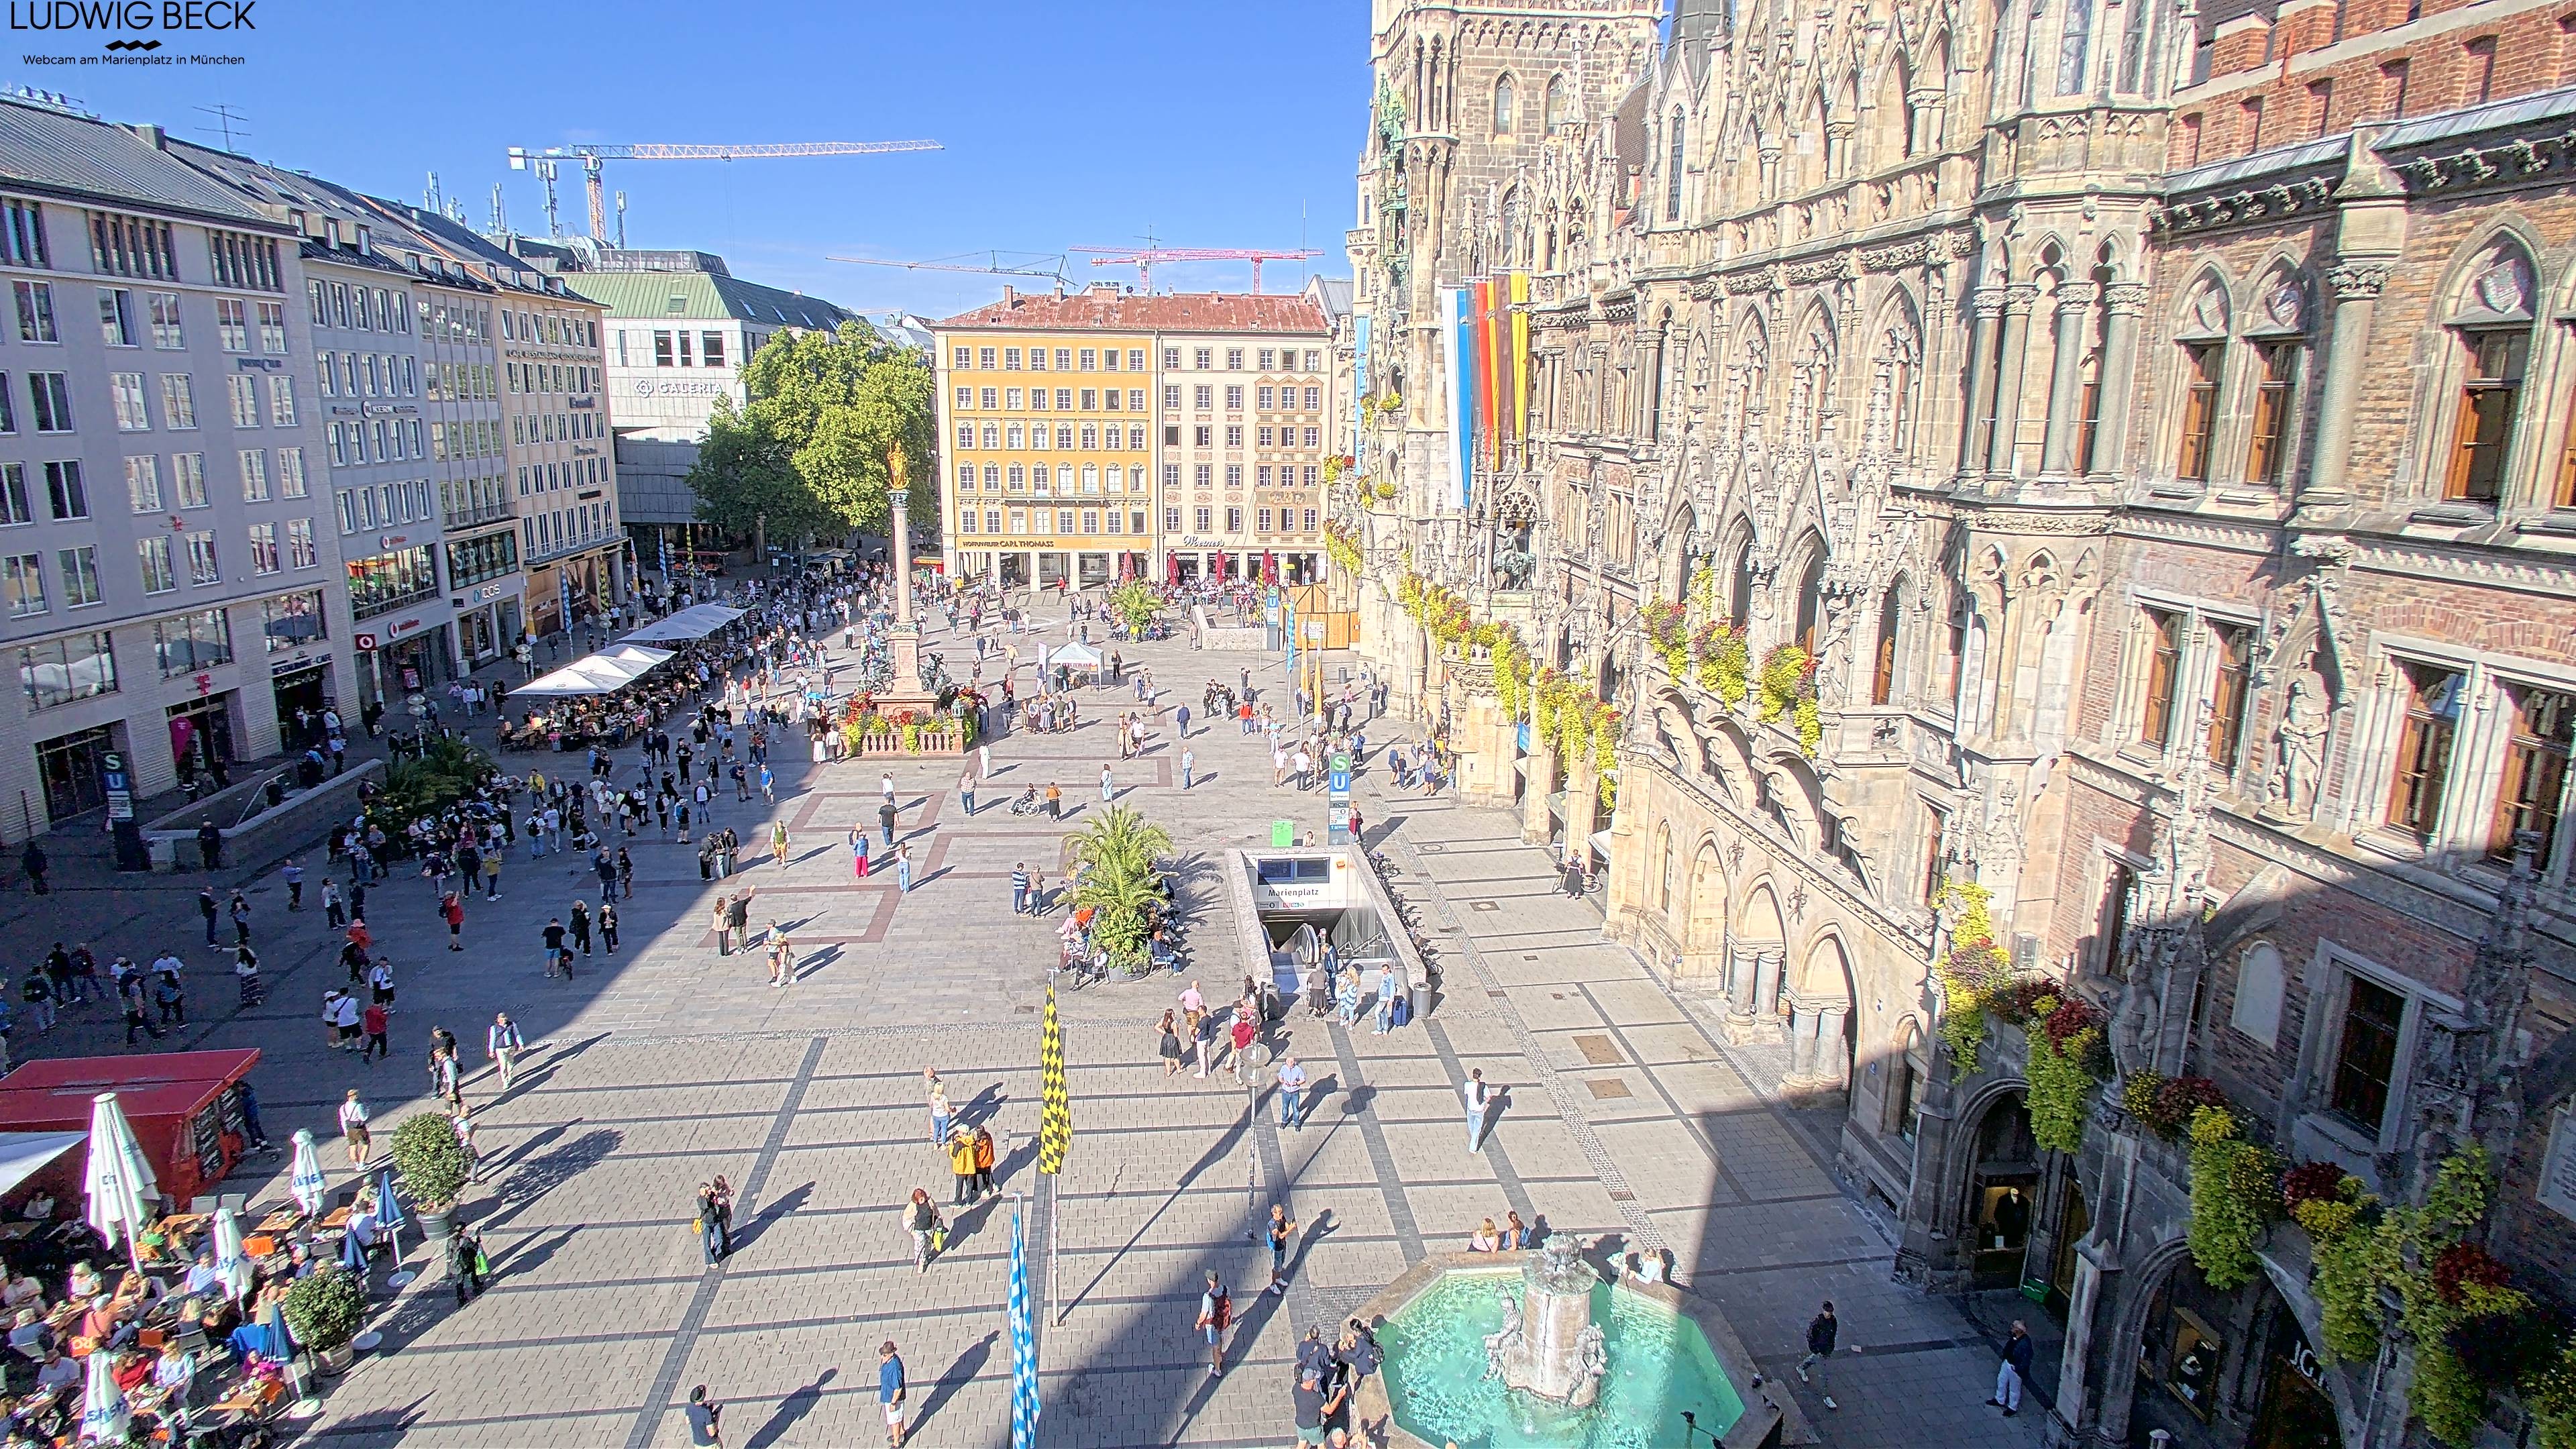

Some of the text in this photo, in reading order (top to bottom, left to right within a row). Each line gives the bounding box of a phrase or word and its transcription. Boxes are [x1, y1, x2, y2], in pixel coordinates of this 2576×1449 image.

[658, 382, 722, 394] GALERIA
[1269, 587, 1277, 596] S
[1269, 597, 1277, 607] U
[105, 754, 121, 769] S
[1334, 755, 1348, 771] S
[108, 774, 123, 789] U
[1334, 775, 1346, 790] U
[1269, 888, 1319, 898] Marienplatz
